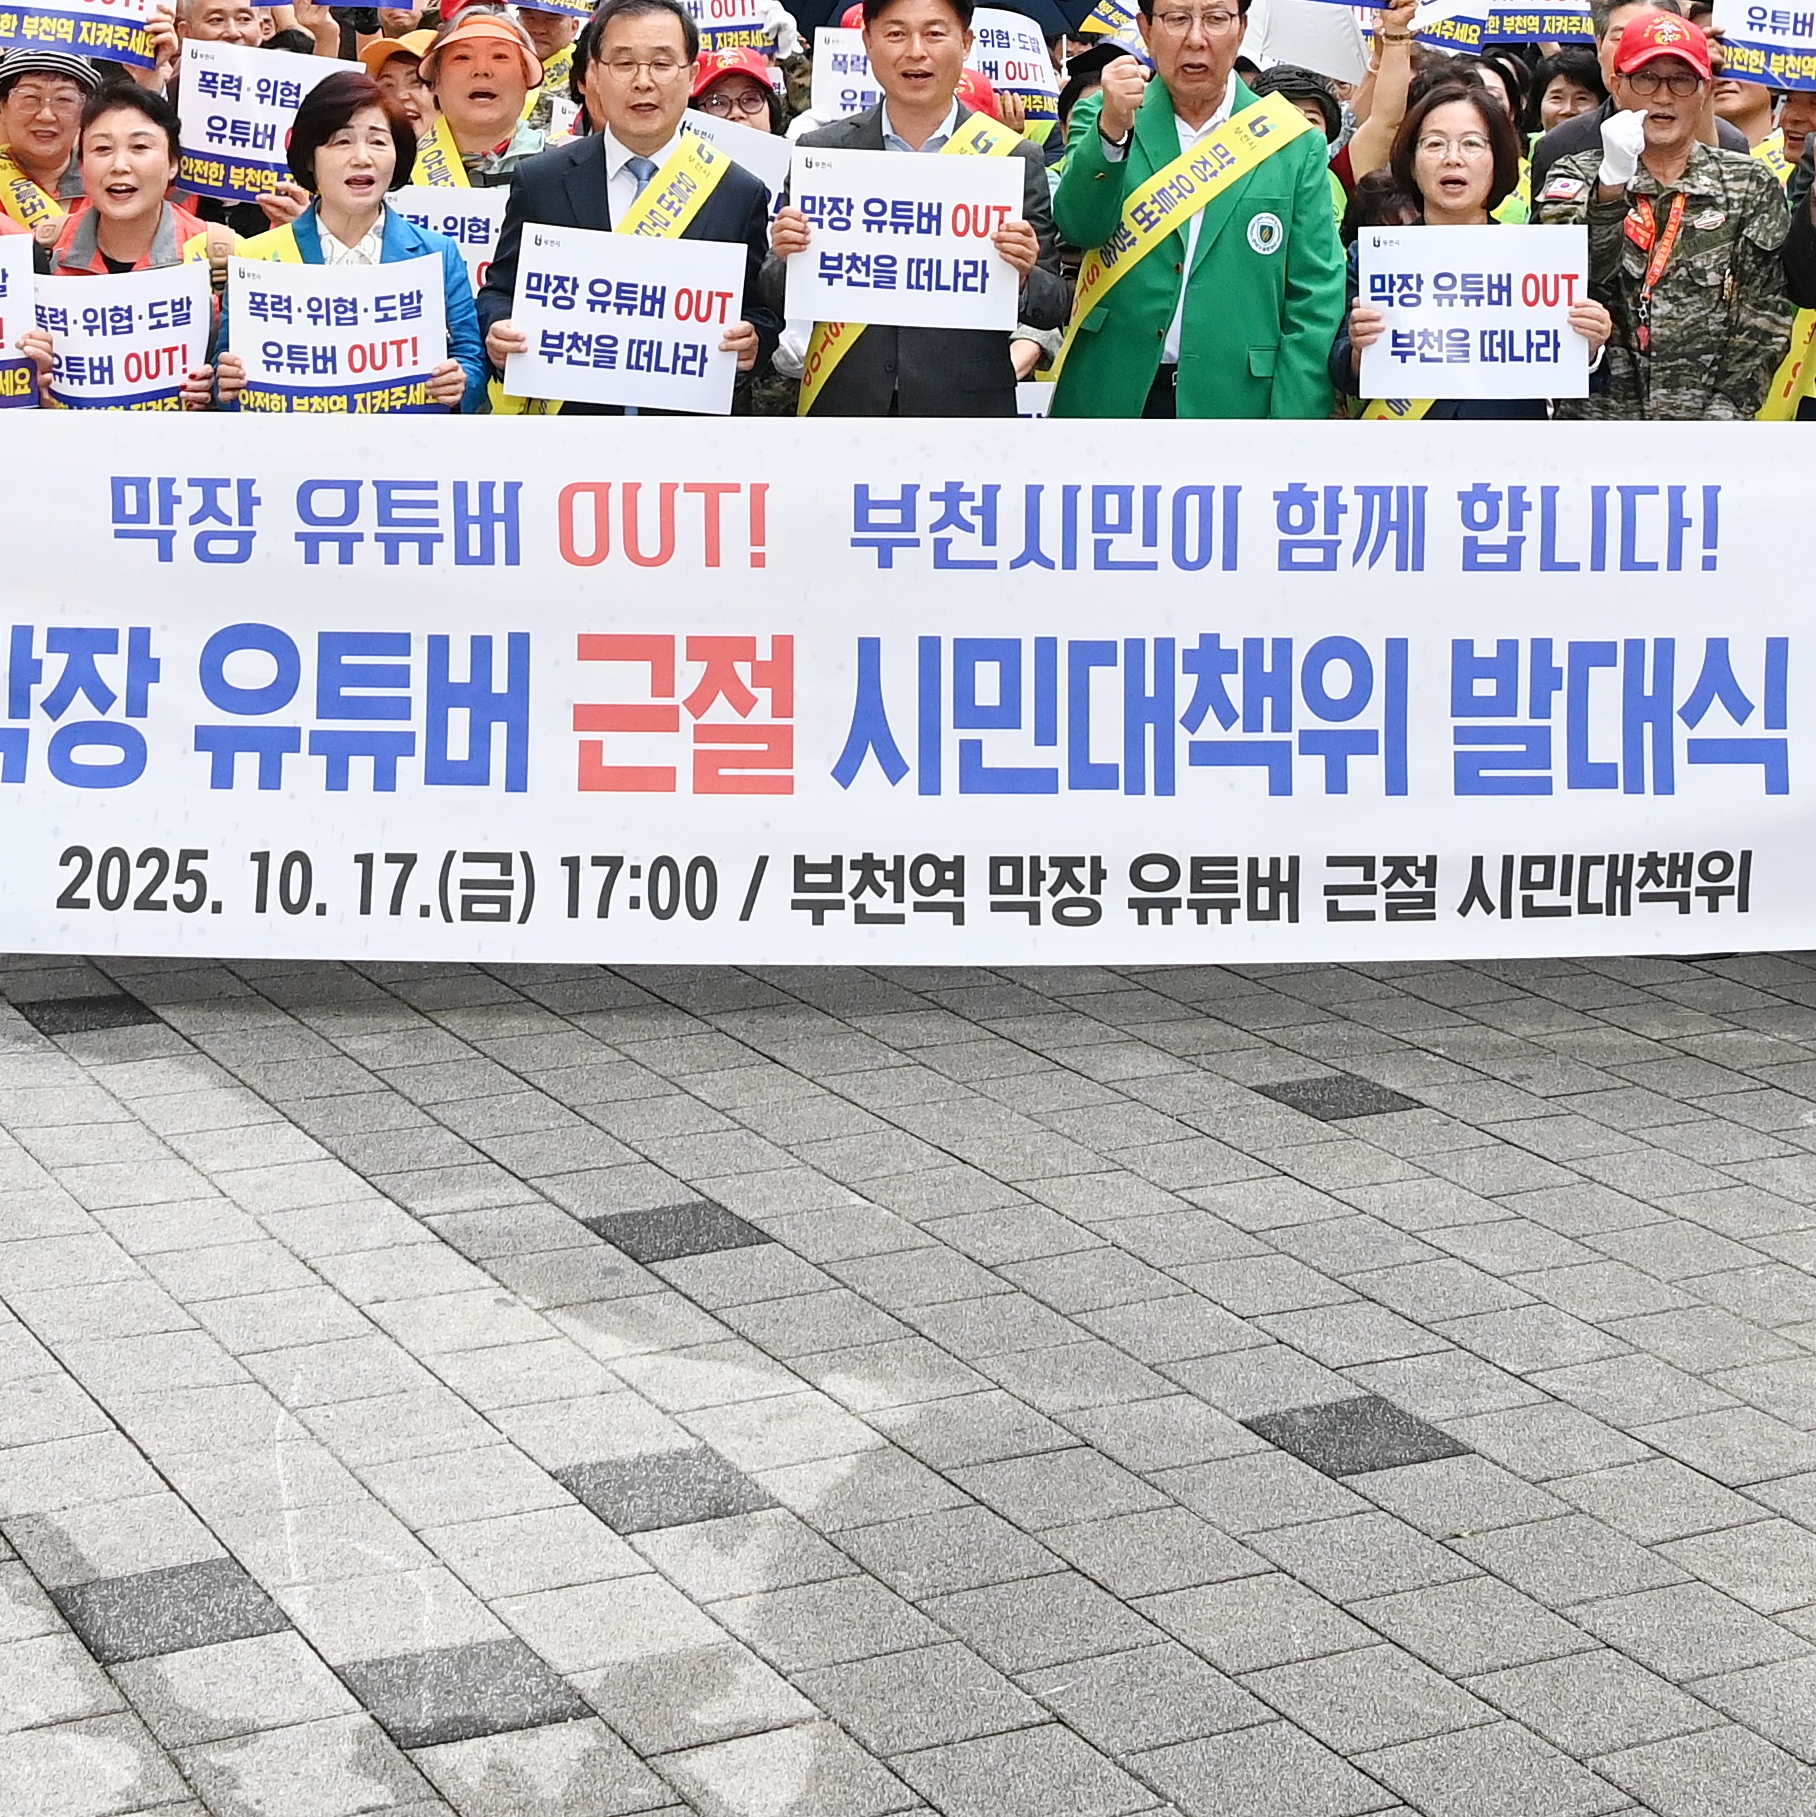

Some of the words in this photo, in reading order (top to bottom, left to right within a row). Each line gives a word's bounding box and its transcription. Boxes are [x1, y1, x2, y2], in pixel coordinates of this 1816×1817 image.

[1189, 141, 1238, 185] 막장
[1134, 170, 1197, 231] 유튜버
[1100, 220, 1140, 270] 방송
[249, 290, 423, 326] 폭력·위협·도발
[525, 272, 579, 310] 막장
[587, 279, 666, 318] 유튜버
[675, 288, 733, 324] OUT
[1370, 274, 1423, 307] 막장
[1434, 272, 1511, 307] 유튜버
[1521, 272, 1579, 308] OUT
[263, 341, 337, 374] 유튜버
[349, 337, 418, 373] OUT!
[539, 330, 618, 369] 부천을
[626, 339, 708, 377] 떠나라
[1391, 329, 1470, 363] 부천을
[1480, 329, 1560, 363] 떠나라
[111, 477, 261, 563] 막장
[295, 480, 522, 565] 유튜버
[559, 482, 769, 568] OUT!
[851, 482, 1242, 571] 부천시민이
[1274, 483, 1428, 571] 함께
[1458, 483, 1721, 571] 합니다!
[194, 623, 530, 792] 유튜버
[574, 634, 794, 795] 근절
[831, 633, 1408, 796] 시민대책위
[1451, 637, 1789, 795] 발대식
[57, 846, 222, 913] 2025.
[251, 851, 326, 915] 10.
[354, 851, 534, 924] 17.(금)
[561, 856, 717, 920] 17:00
[739, 856, 769, 921] /
[791, 853, 964, 925] 부천역
[990, 856, 1106, 926] 막장
[1128, 854, 1299, 925] 유튜버
[1324, 855, 1437, 921] 근절
[1457, 850, 1752, 919] 시민대책위
